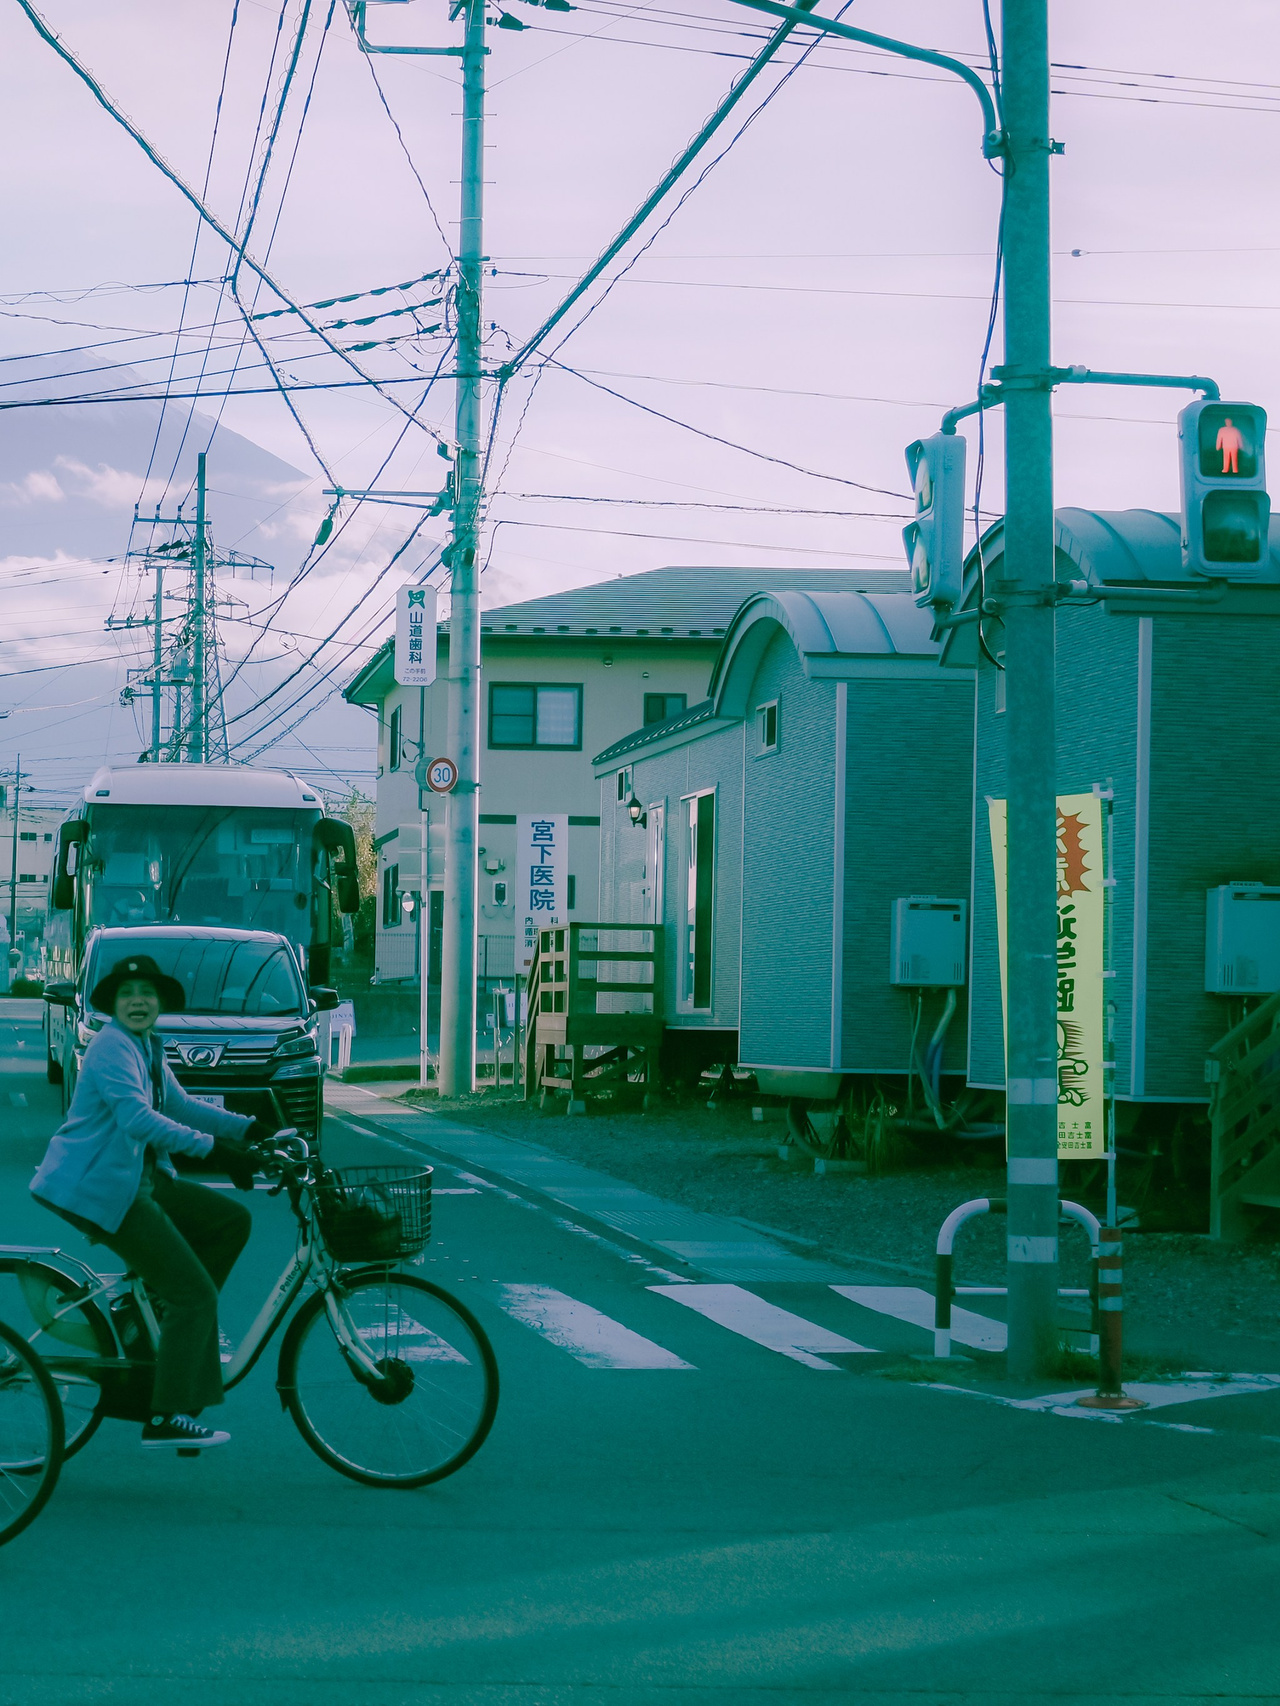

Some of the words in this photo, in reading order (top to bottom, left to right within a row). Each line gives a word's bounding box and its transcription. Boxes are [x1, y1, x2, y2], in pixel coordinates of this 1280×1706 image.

[408, 611, 423, 664] 山道歯科
[434, 767, 451, 783] 30
[529, 819, 556, 911] 宮下医院
[279, 1260, 304, 1293] Peltech
